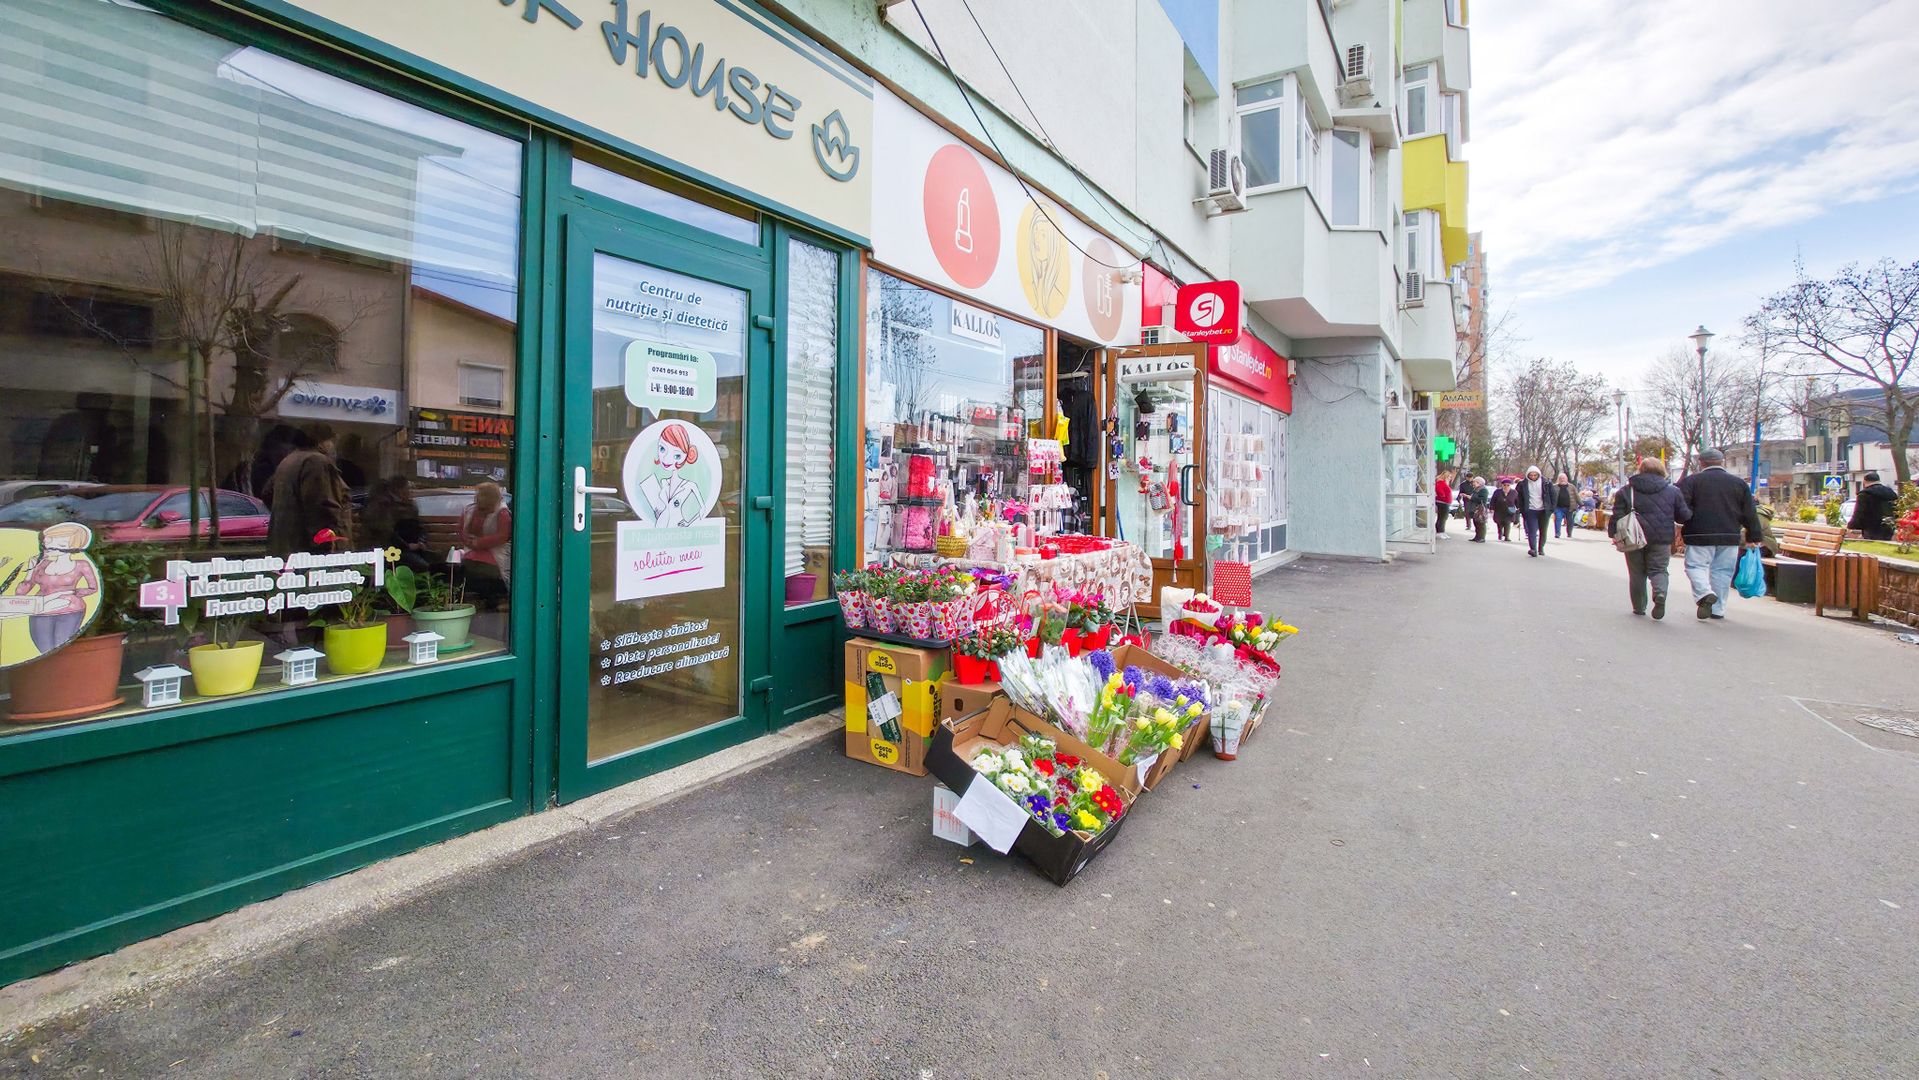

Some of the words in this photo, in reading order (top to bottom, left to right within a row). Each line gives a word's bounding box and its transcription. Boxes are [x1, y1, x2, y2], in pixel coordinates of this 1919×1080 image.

[601, 0, 802, 139] HOUSE
[640, 281, 683, 301] Centru
[687, 292, 702, 305] de
[606, 297, 658, 317] nutriție
[662, 308, 673, 322] și
[677, 311, 729, 331] dietetică
[191, 575, 274, 597] Naturale
[276, 572, 306, 589] din
[309, 569, 365, 586] Plante,
[206, 597, 266, 617] Fructe
[287, 590, 352, 610] Legume
[614, 650, 646, 666] Diete
[614, 662, 673, 684] Reeducare
